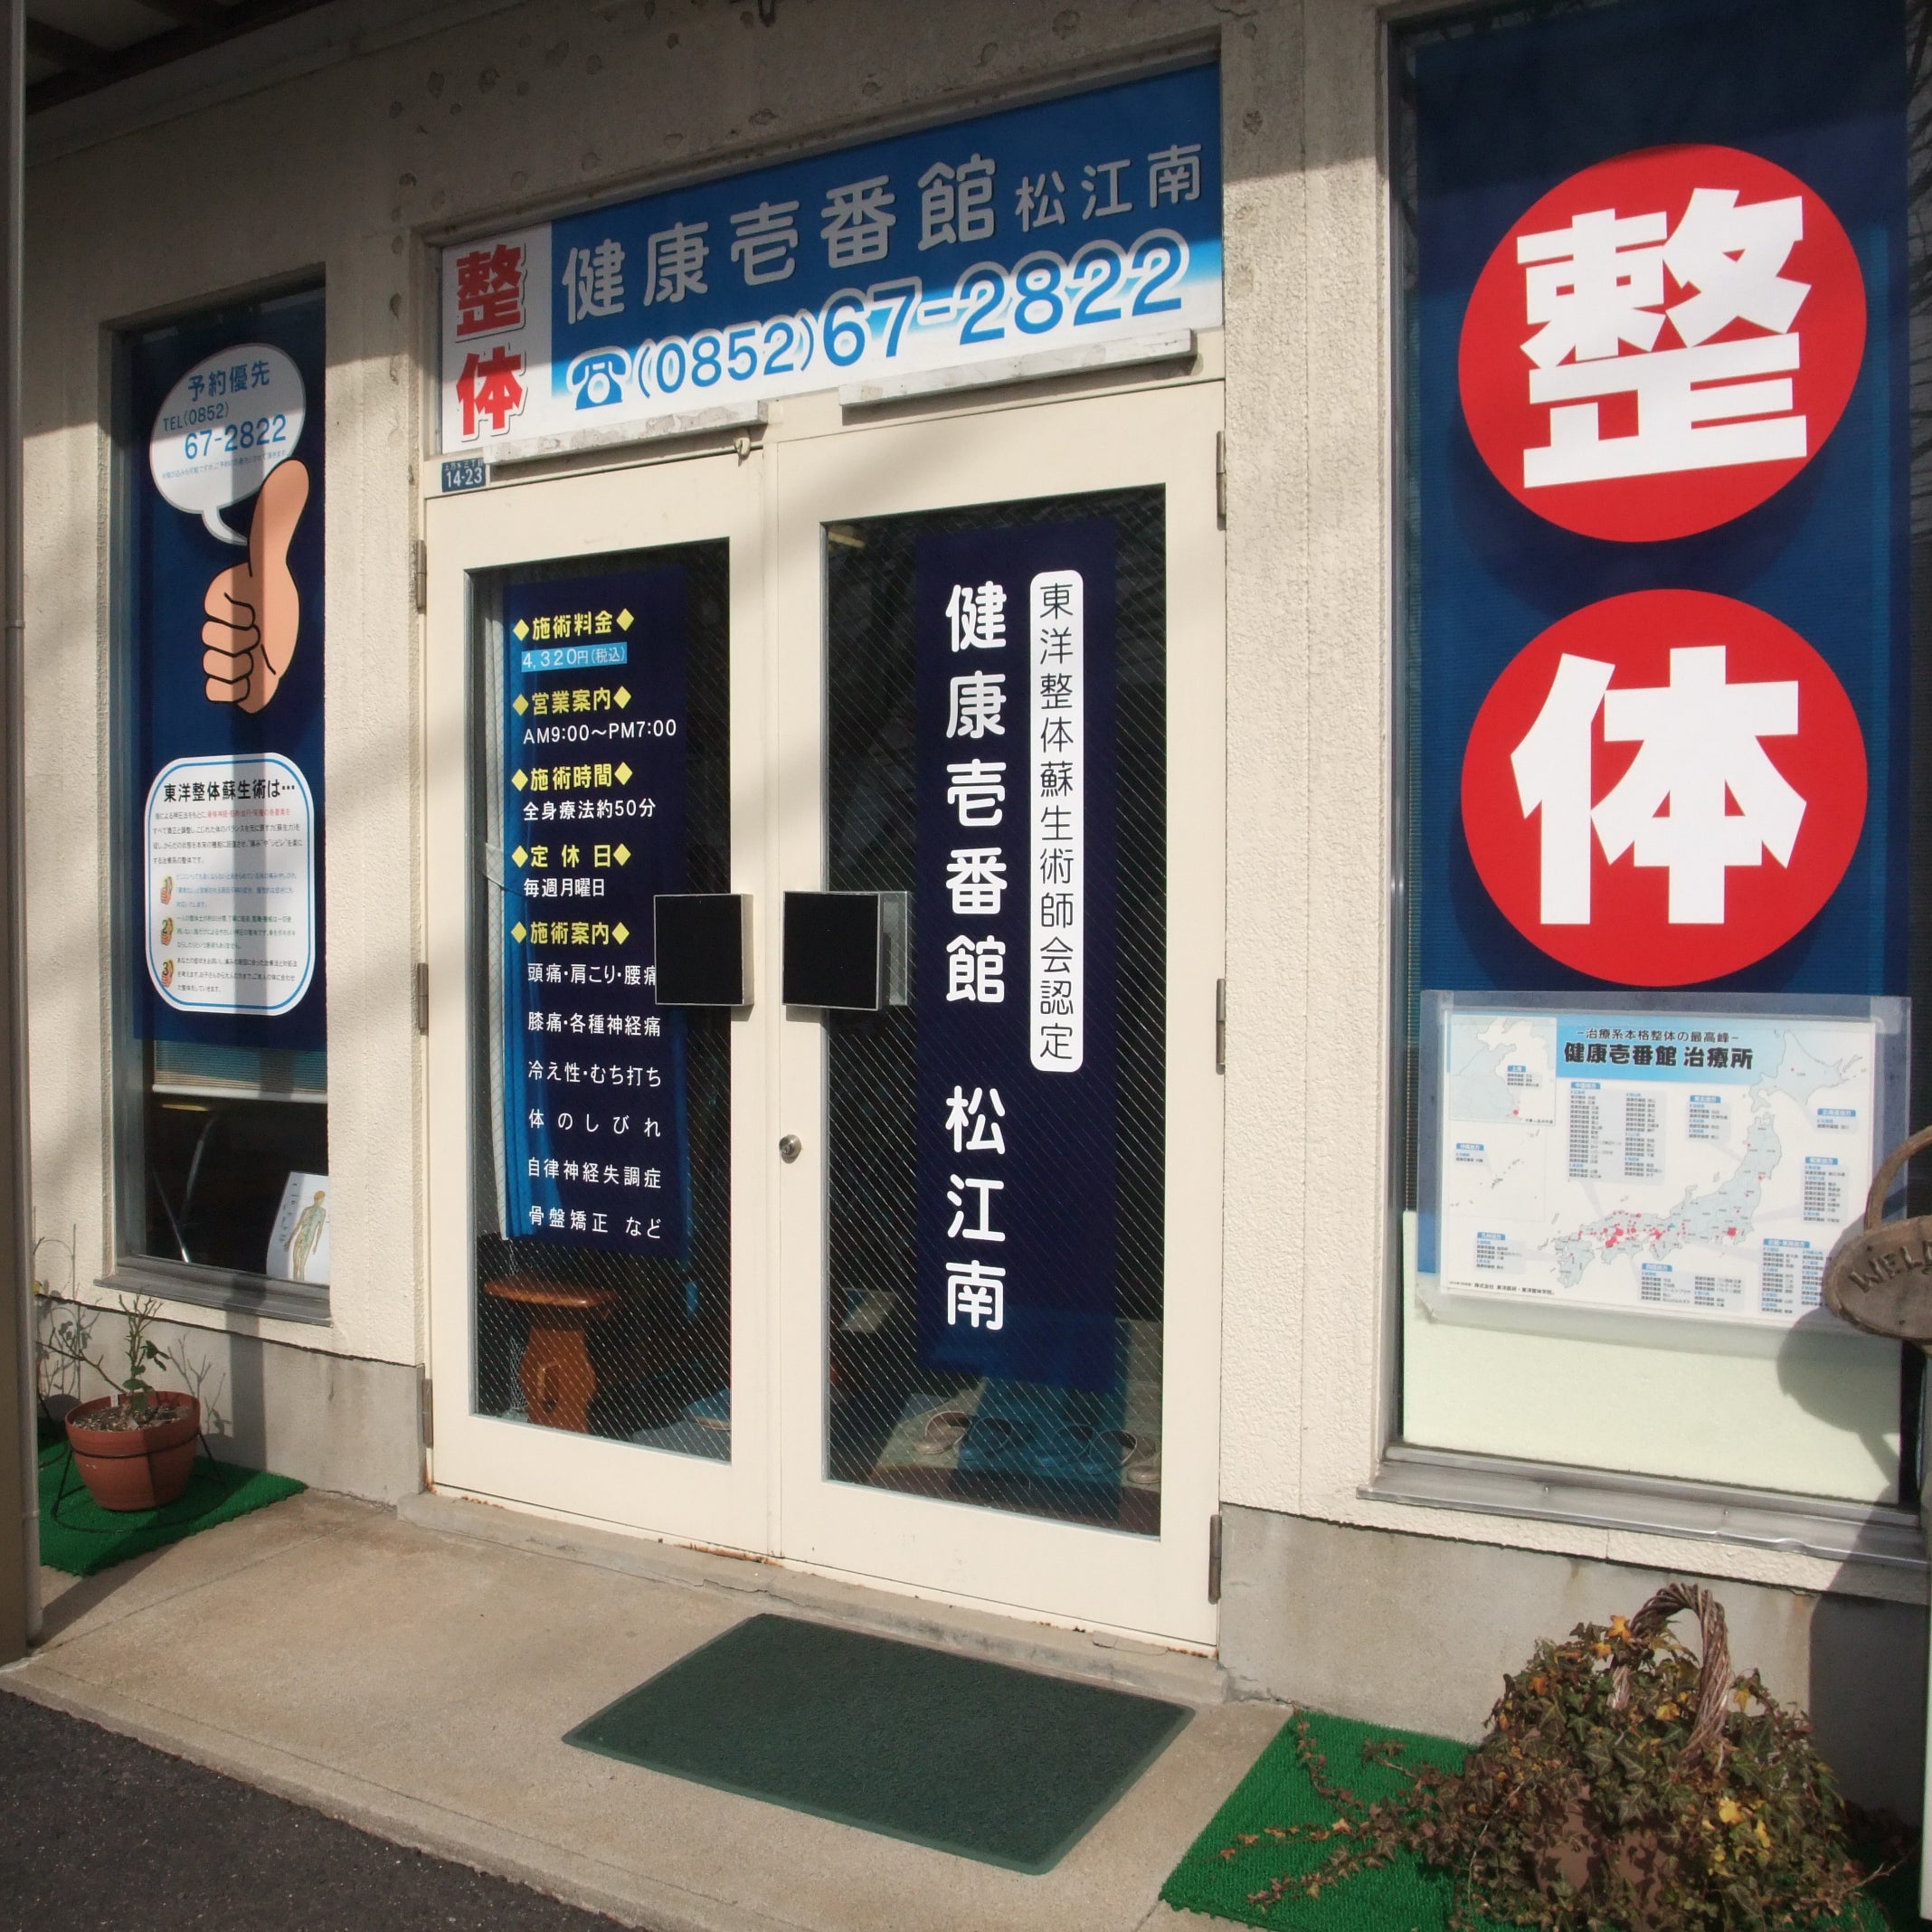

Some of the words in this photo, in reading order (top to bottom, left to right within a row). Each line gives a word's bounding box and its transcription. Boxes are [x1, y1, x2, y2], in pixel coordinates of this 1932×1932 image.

[561, 153, 998, 324] 健康壱番館
[1015, 143, 1203, 233] 松江南
[455, 242, 527, 440] 整体
[187, 360, 270, 402] 予約優先
[163, 402, 230, 431] TEL(0852)
[185, 413, 287, 459] 67-2822
[446, 467, 482, 488] 14-23
[1511, 186, 1812, 926] 整体
[532, 610, 613, 640] 施術料金
[532, 687, 611, 716] 営業案内
[530, 763, 612, 792] 施術時間
[945, 583, 1008, 1005] 健康壱番館
[523, 798, 657, 821] 全身療法約50分
[1039, 582, 1075, 1062] 東洋整体蘇生術師会認定
[524, 877, 605, 898] 毎週月曜日
[530, 921, 609, 945] 施術案内
[527, 1011, 661, 1037] 膝痛・各種神経痛
[1564, 1041, 1677, 1066] 健康壱番館
[1683, 1046, 1754, 1070] 治療所
[527, 1060, 661, 1087] 冷え性・むち打ち
[527, 1157, 661, 1189] 自律神経失調症
[528, 1206, 609, 1234] 骨盤矯正
[625, 1219, 662, 1239] など
[945, 1084, 1007, 1332] 松江南
